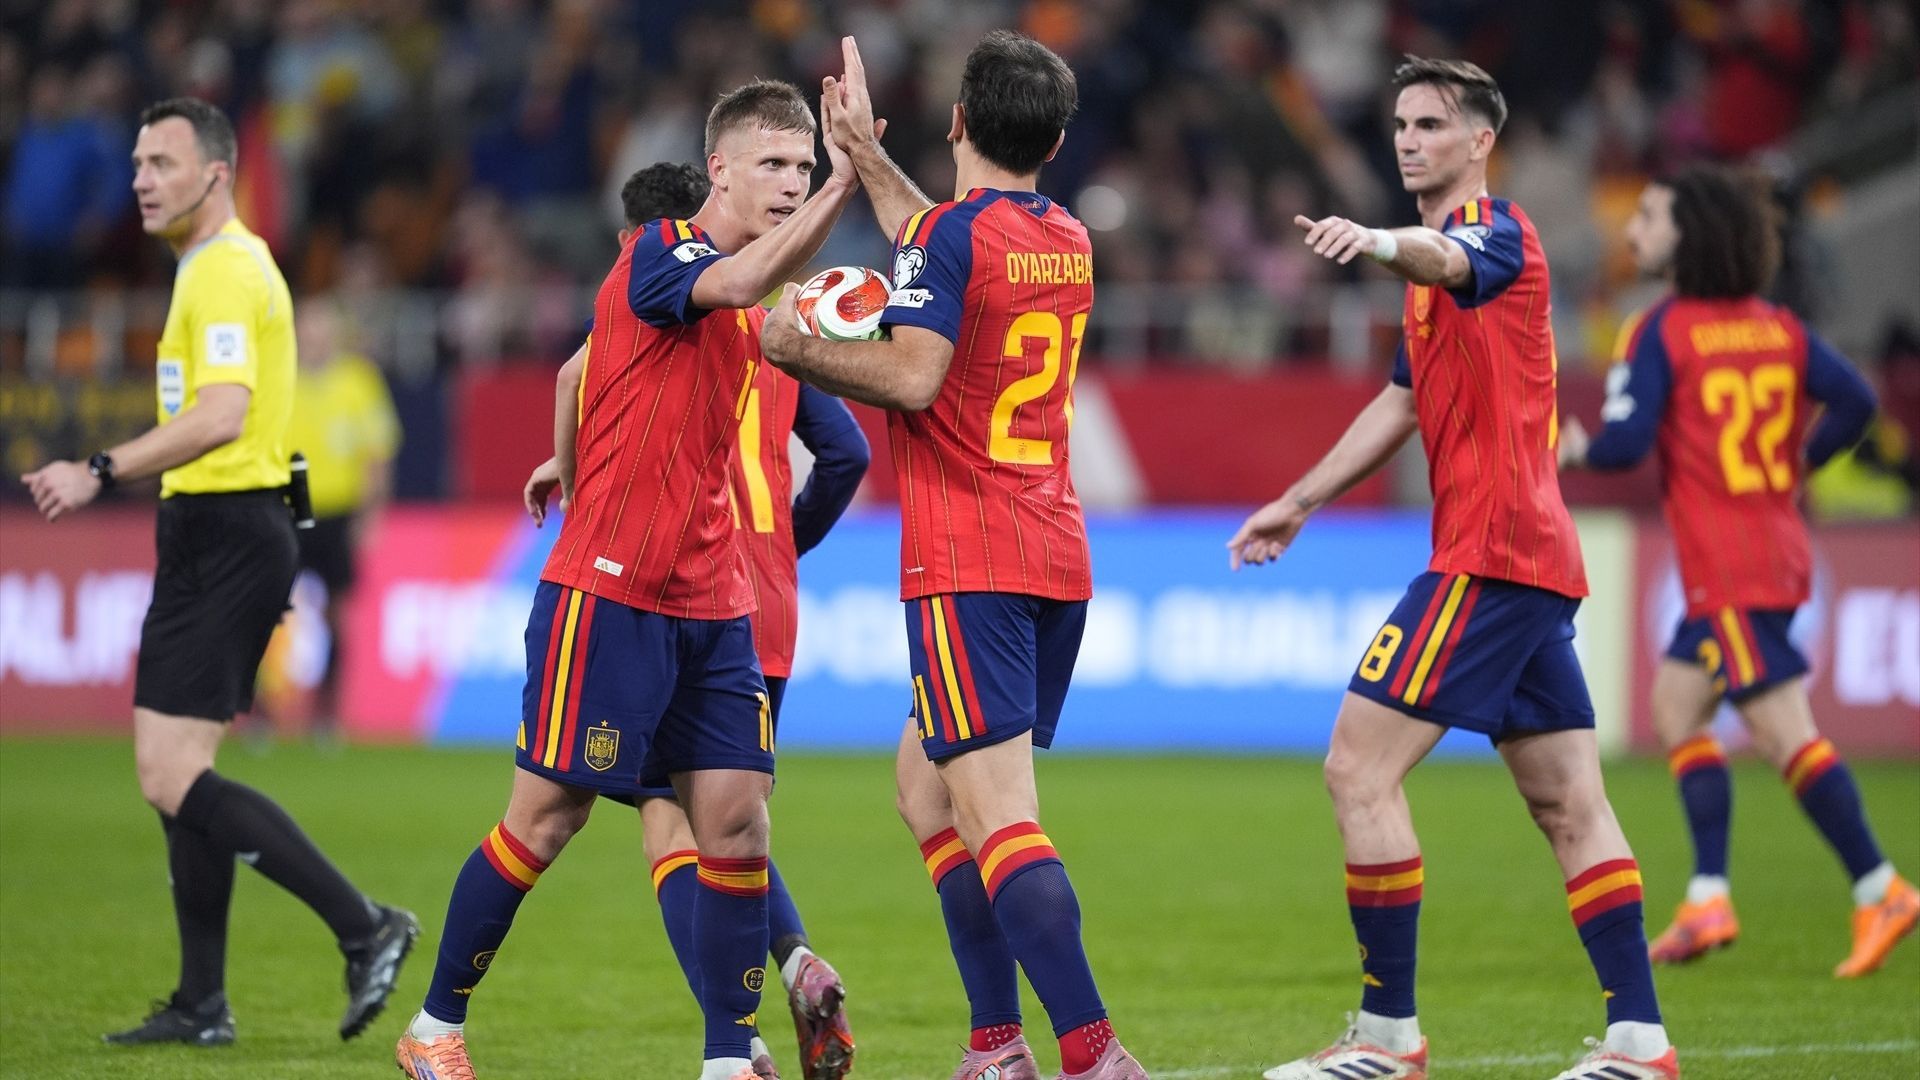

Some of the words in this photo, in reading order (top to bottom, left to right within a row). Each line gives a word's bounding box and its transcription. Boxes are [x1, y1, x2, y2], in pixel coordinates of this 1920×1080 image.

[1006, 252, 1094, 285] OYARZABA
[1701, 363, 1797, 496] 22
[1359, 624, 1403, 682] 8
